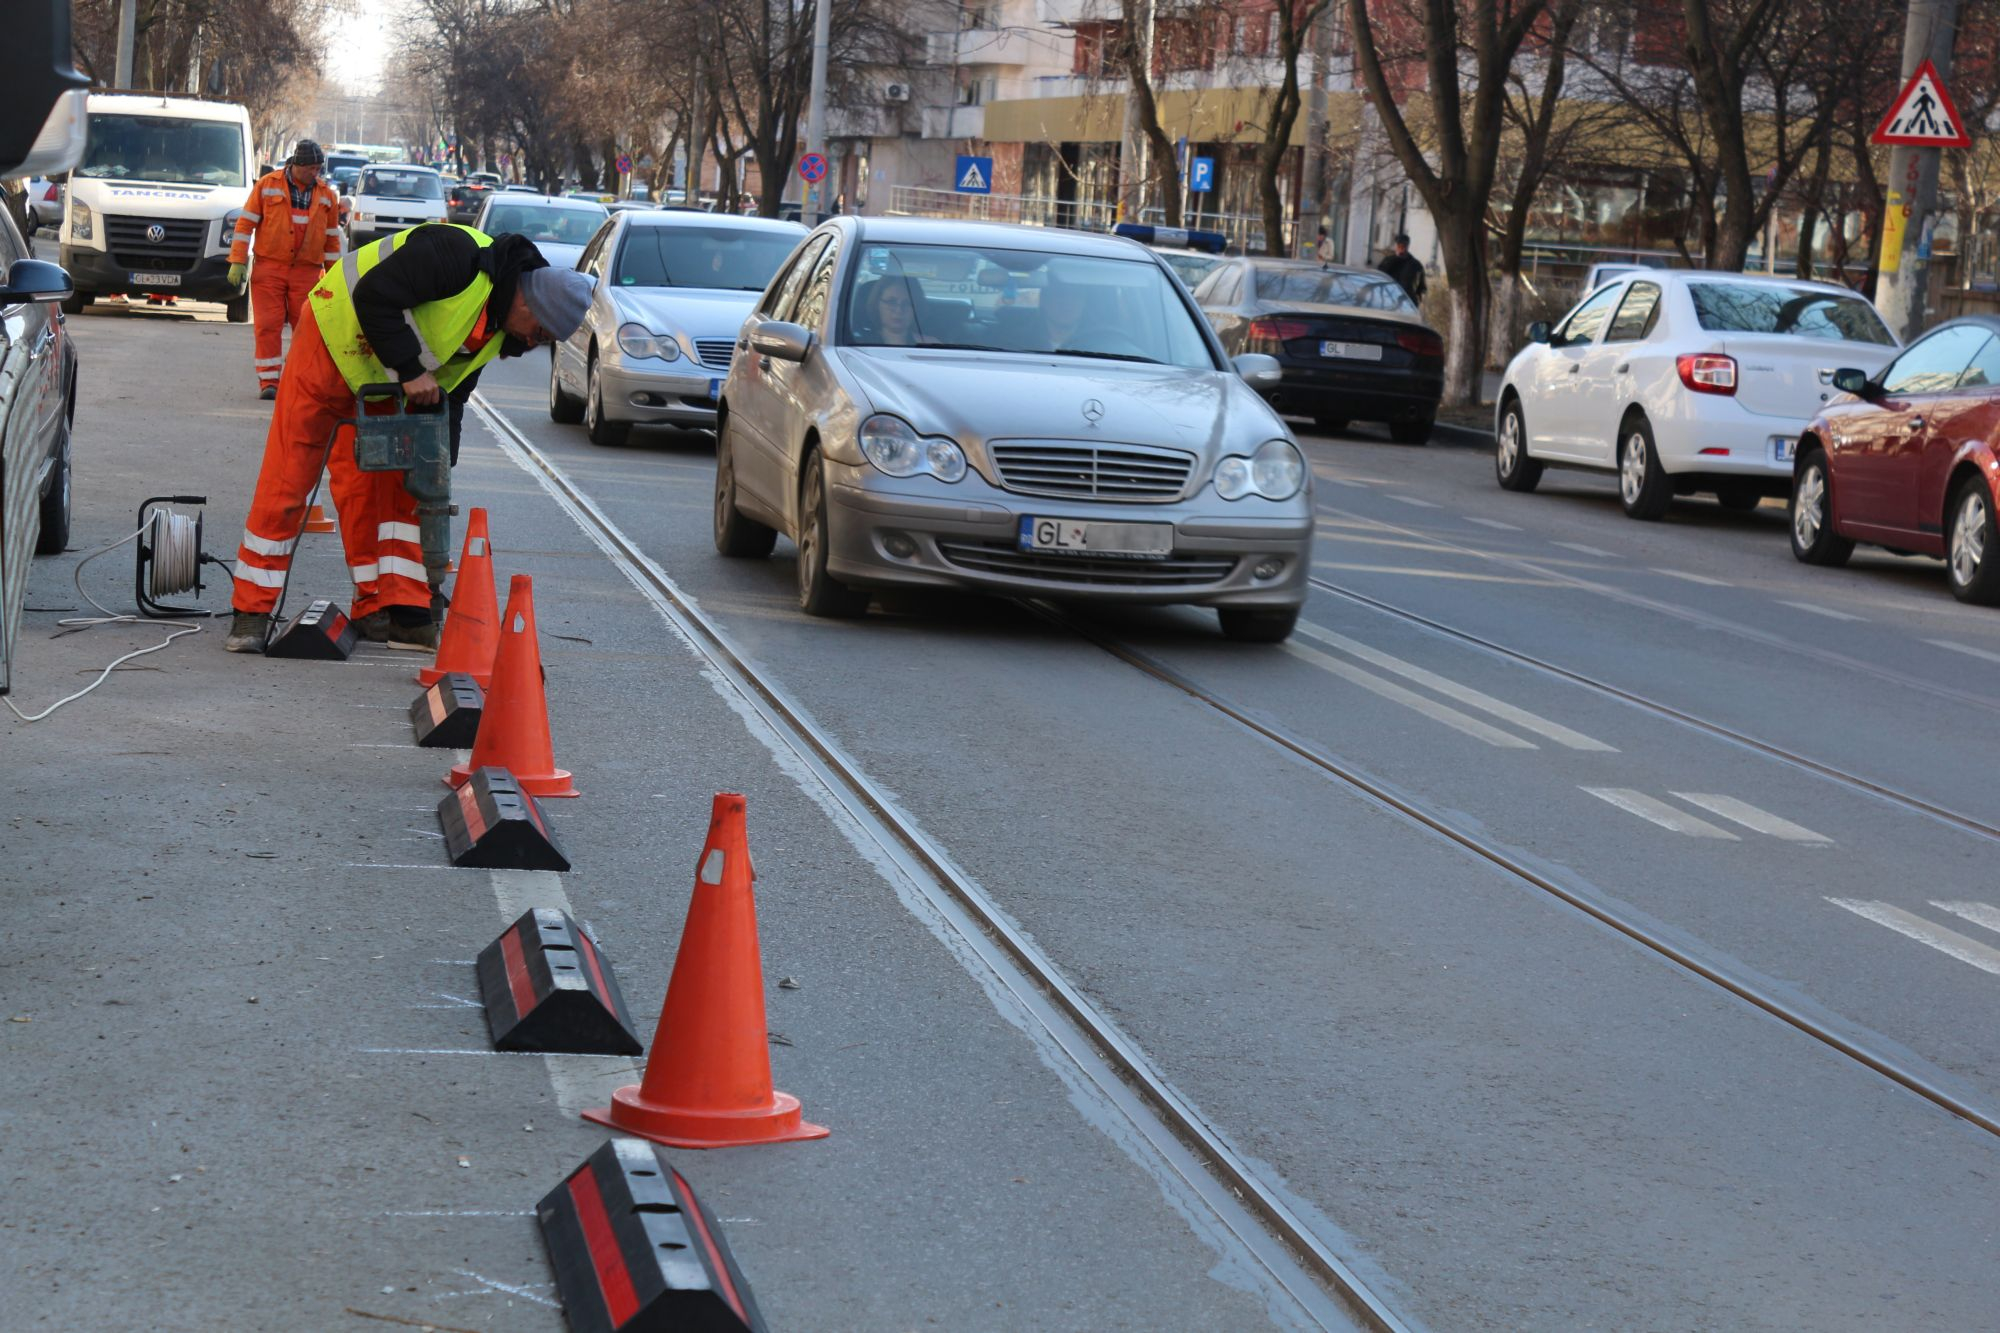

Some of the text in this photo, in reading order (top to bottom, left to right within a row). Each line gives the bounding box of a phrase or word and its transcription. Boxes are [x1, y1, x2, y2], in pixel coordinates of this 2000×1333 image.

[1196, 163, 1208, 182] P
[112, 189, 207, 200] TANCRAD
[1037, 522, 1069, 547] GL
